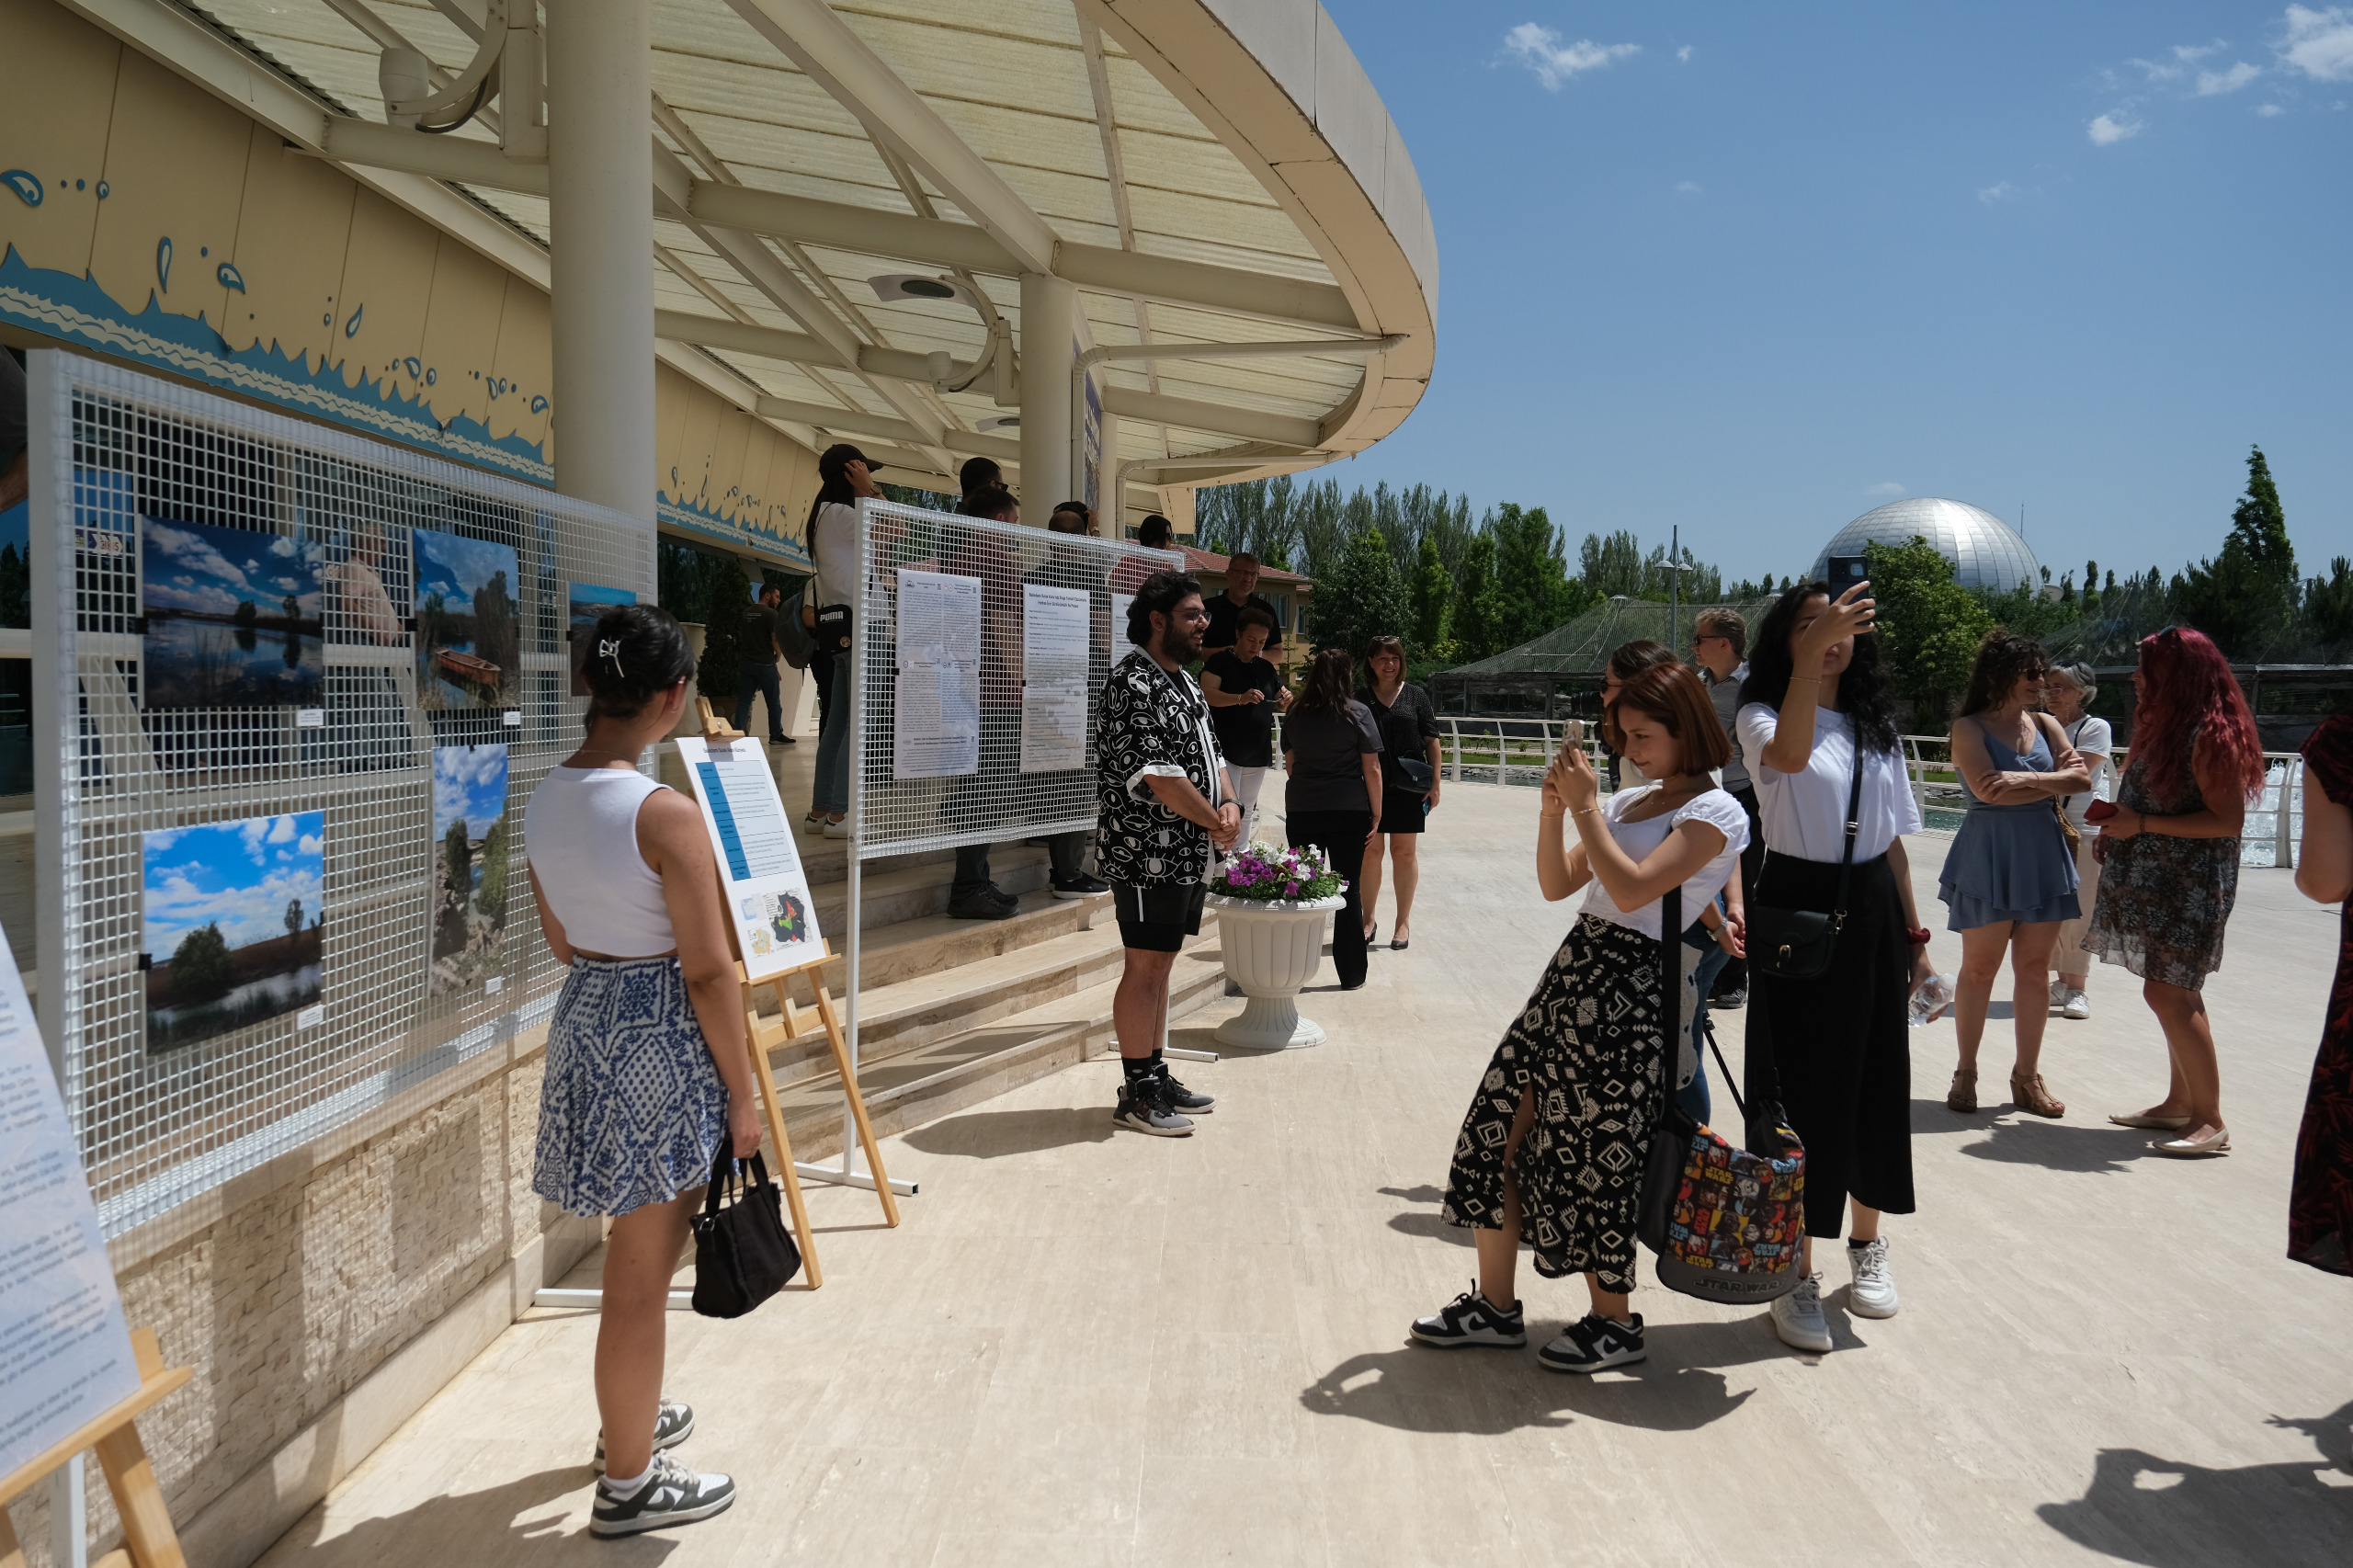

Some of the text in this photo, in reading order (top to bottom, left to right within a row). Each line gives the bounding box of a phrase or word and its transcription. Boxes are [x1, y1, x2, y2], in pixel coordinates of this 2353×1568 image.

[820, 610, 844, 622] PUMA
[1705, 1165, 1733, 1180] STAR
[1705, 1171, 1734, 1185] WARS
[1686, 1255, 1713, 1267] STAR
[1693, 1276, 1744, 1293] STAR
